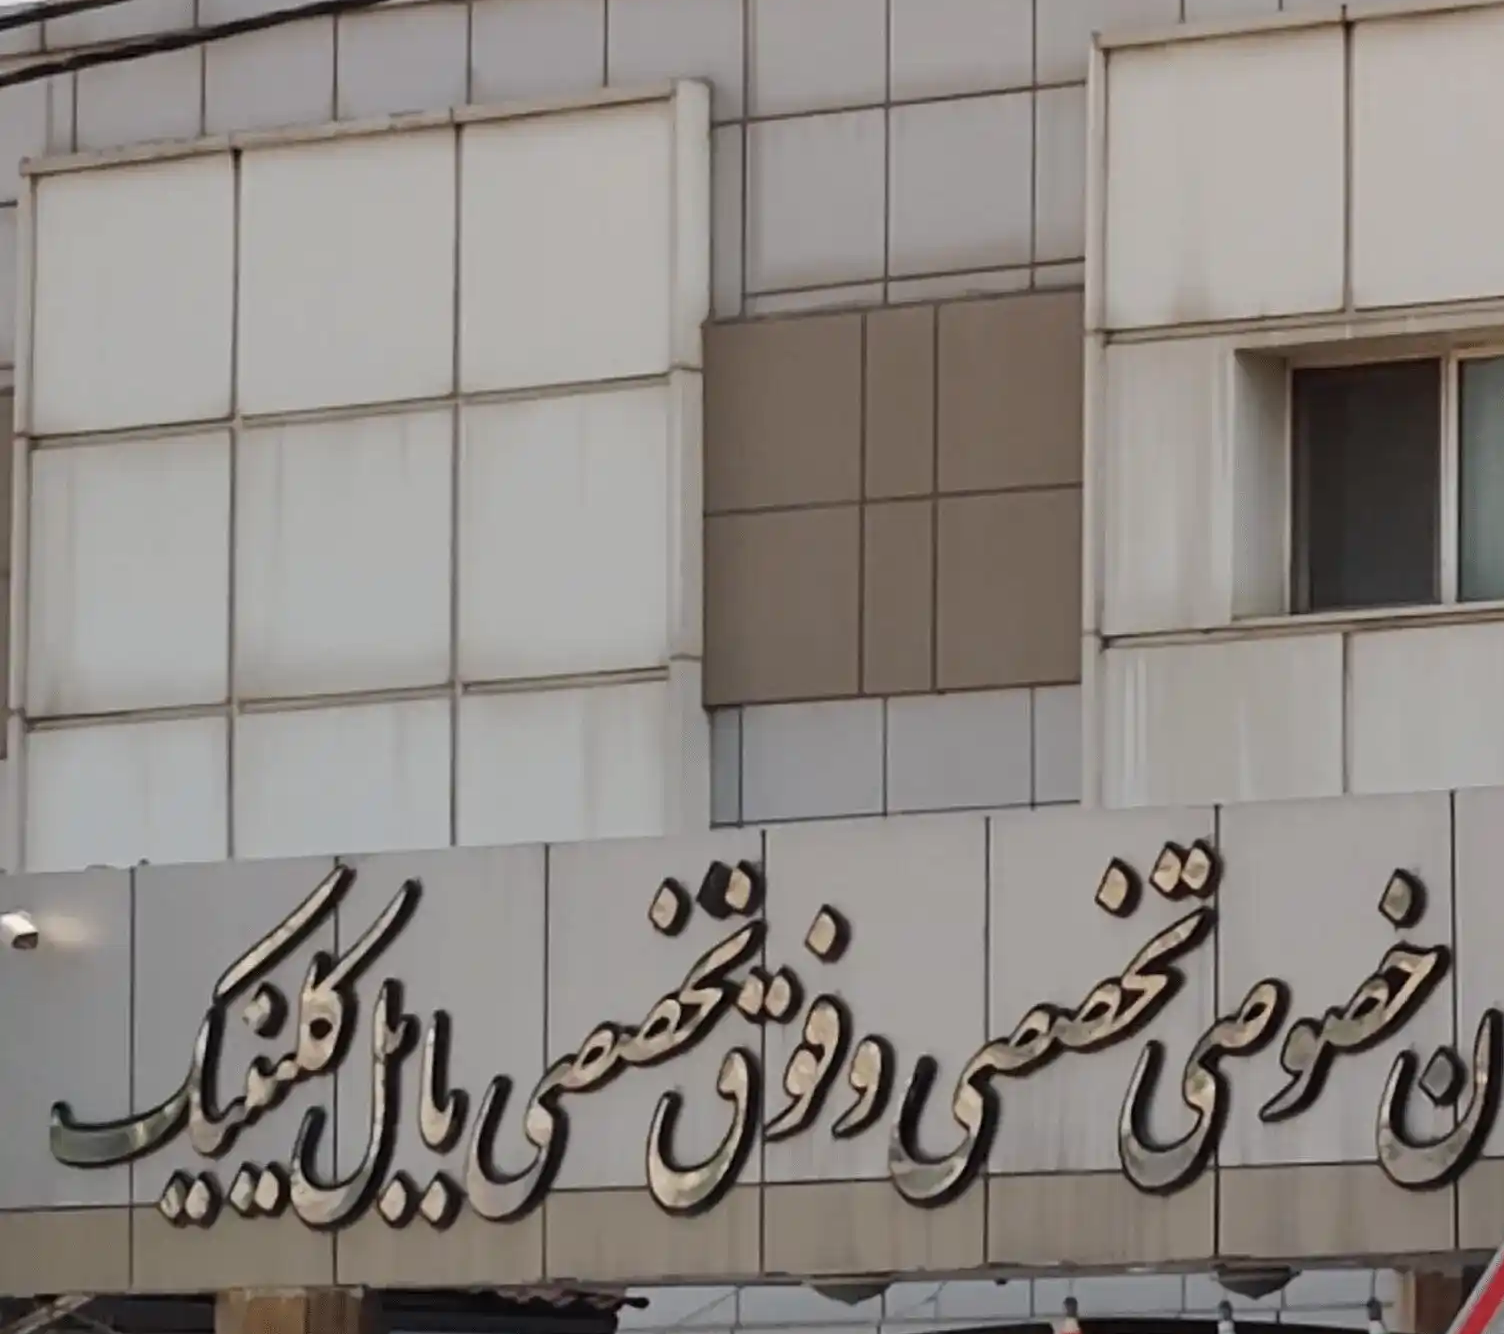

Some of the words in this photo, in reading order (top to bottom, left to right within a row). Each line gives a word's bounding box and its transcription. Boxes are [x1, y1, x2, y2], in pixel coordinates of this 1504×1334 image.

[49, 864, 422, 1227] کلینیک
[290, 979, 471, 1229] بابل
[467, 859, 766, 1223] تخصصی
[646, 905, 851, 1217] فوق
[831, 1034, 893, 1139] و
[887, 840, 1220, 1208] تخصصی
[1119, 869, 1452, 1197] خصوصی
